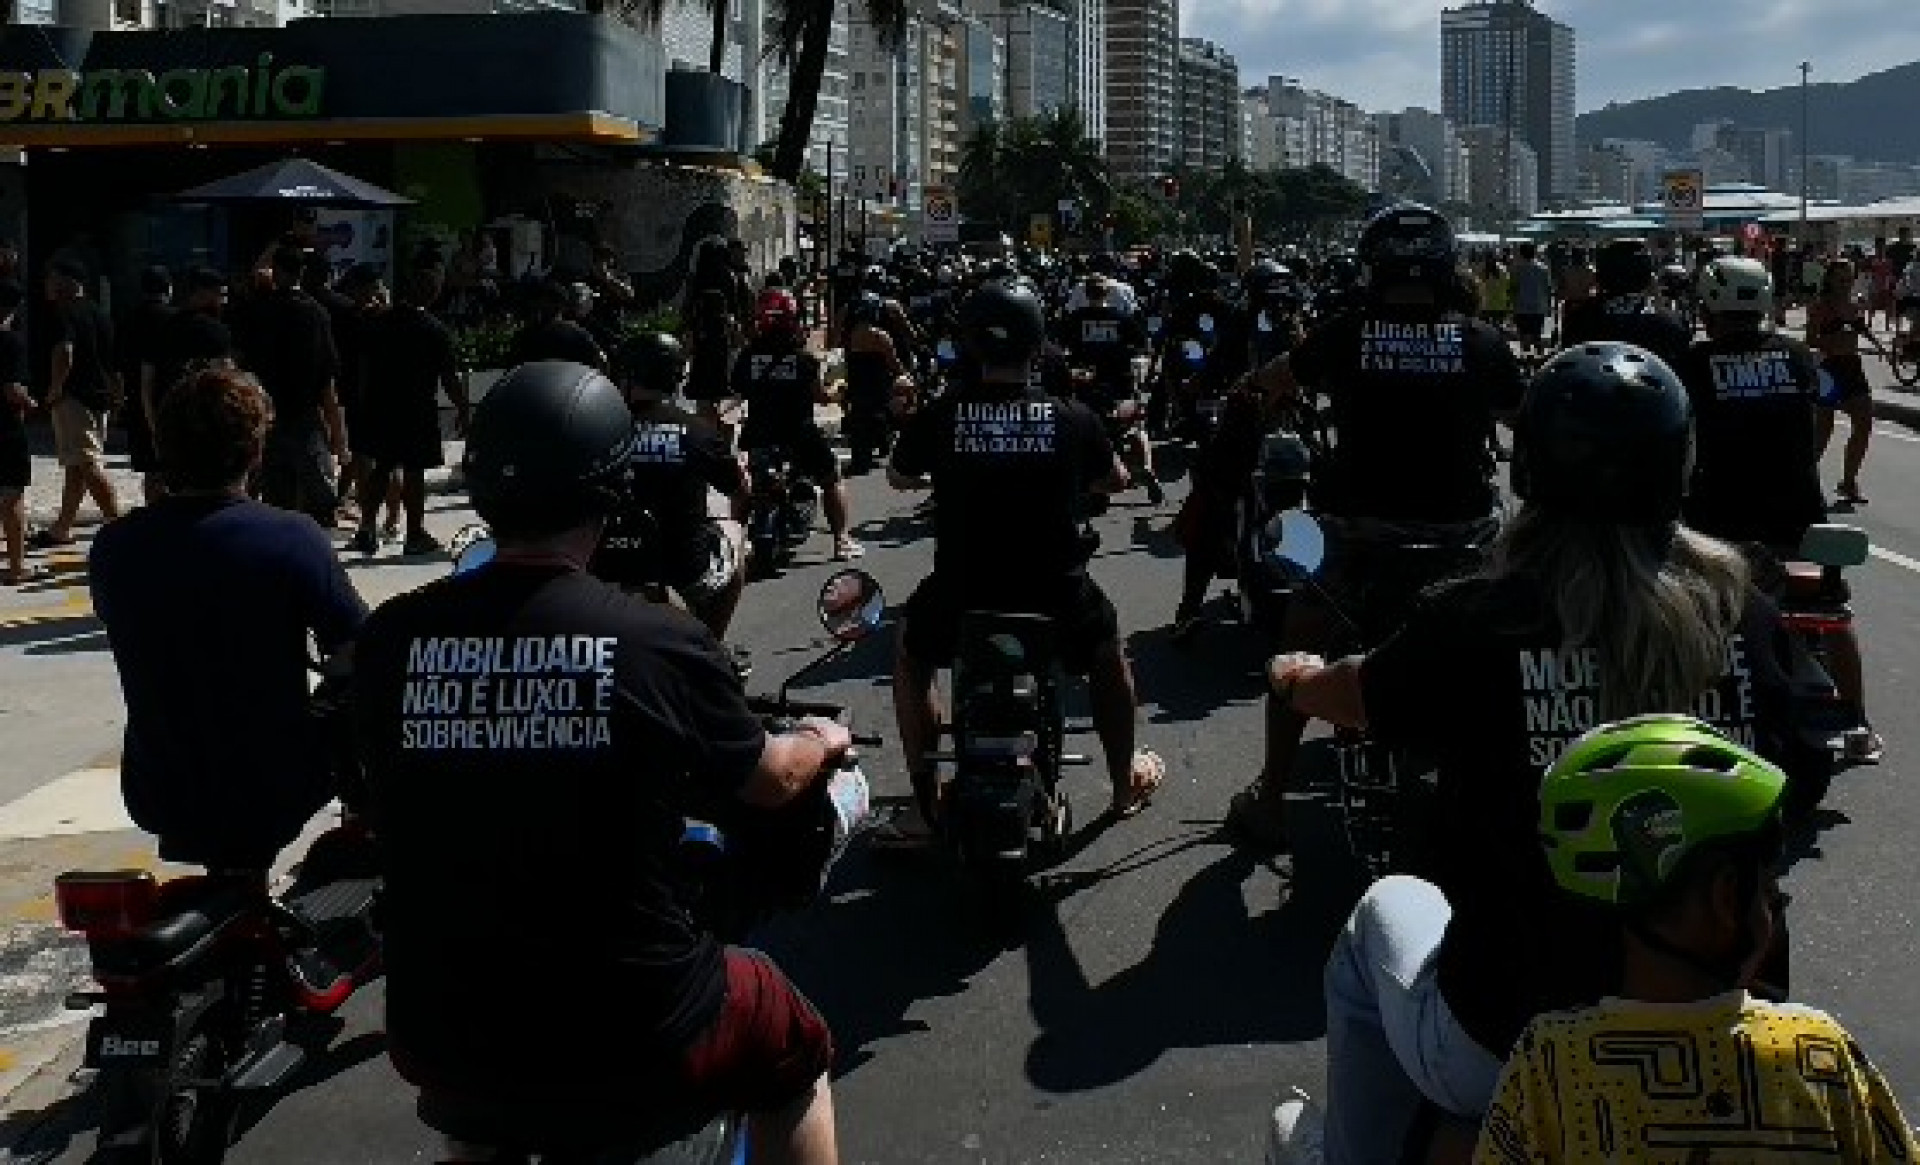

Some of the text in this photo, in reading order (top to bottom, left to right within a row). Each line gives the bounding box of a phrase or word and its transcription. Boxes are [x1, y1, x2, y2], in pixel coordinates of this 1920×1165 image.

[1434, 323, 1463, 342] DE
[1028, 402, 1056, 421] DE
[406, 635, 618, 673] MOBILIDADE
[402, 668, 615, 715] NÃO É LUXO. É
[402, 709, 611, 749] SOBREVIVÊNCIA
